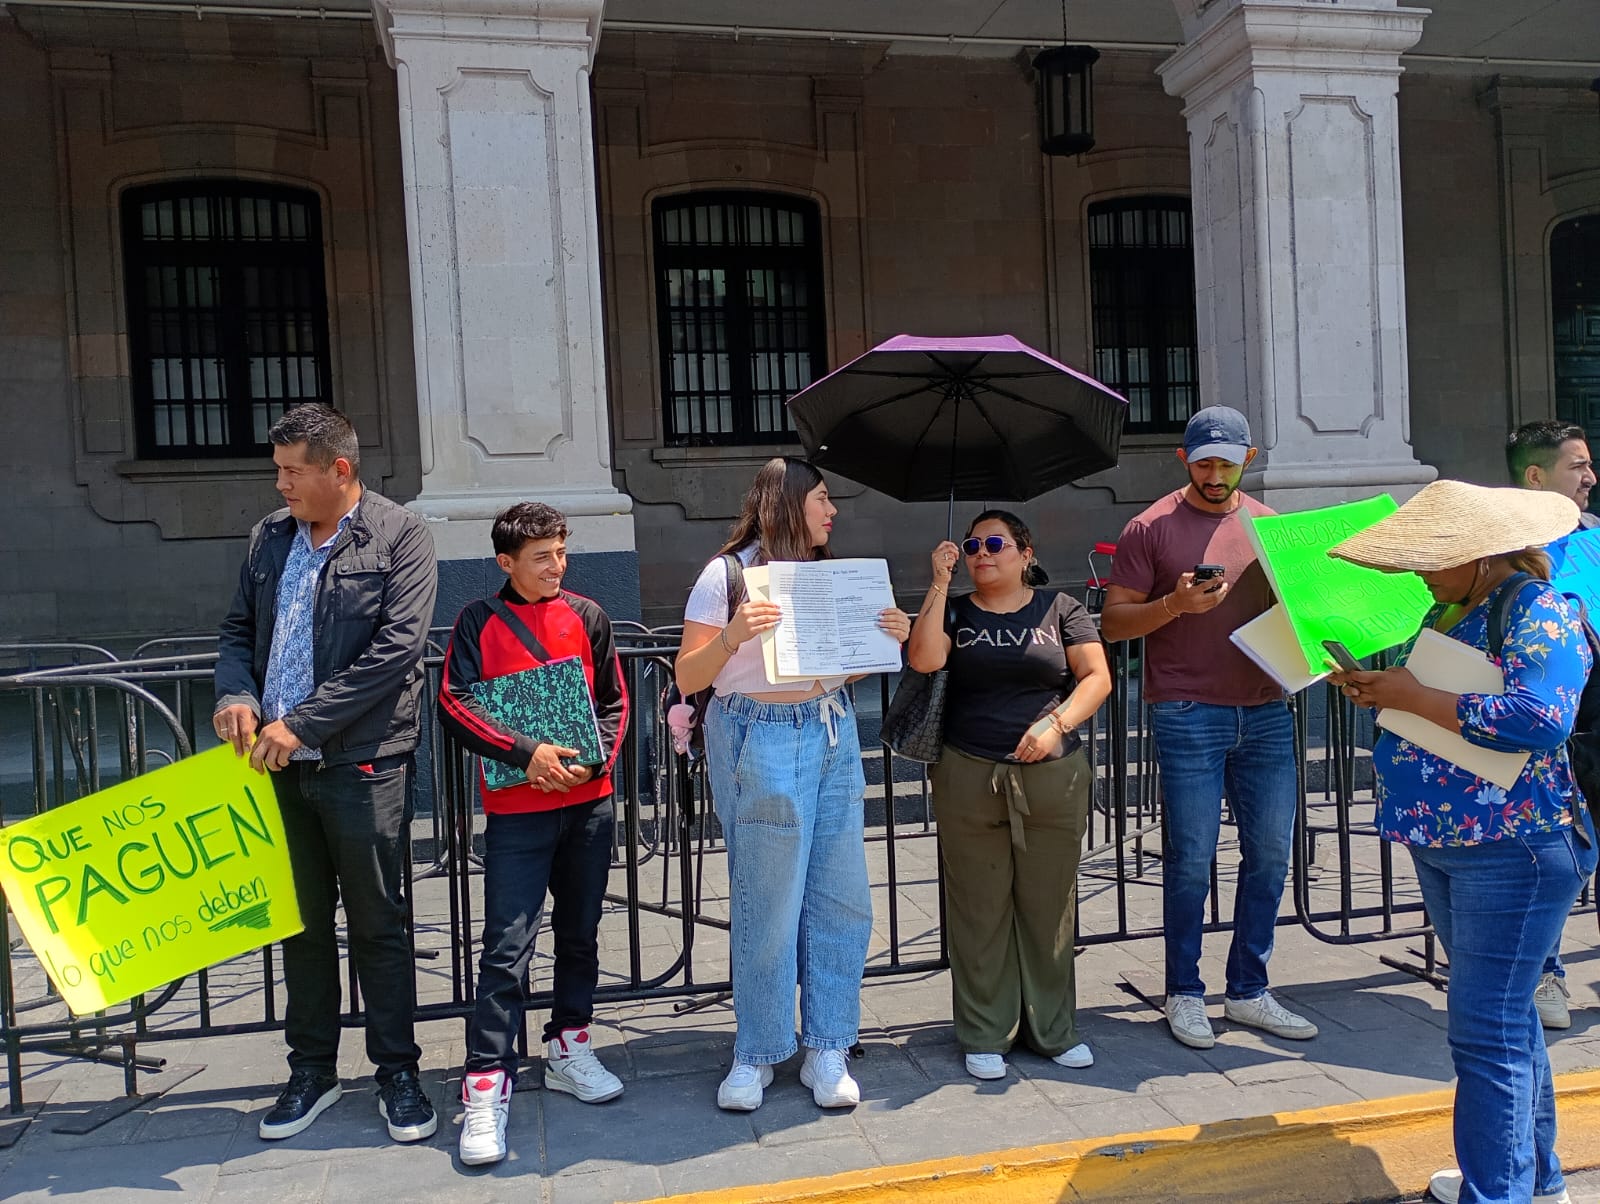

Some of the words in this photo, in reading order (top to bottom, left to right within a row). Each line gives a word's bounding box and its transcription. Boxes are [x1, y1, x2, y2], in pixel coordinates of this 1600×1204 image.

[956, 625, 1060, 648] CALVIN
[8, 825, 92, 873] QUE
[102, 795, 166, 837] NOS
[34, 785, 276, 934] PAGUEN
[44, 949, 82, 989] lo
[89, 940, 137, 984] que
[141, 914, 193, 952] nos
[197, 875, 269, 923] deben
